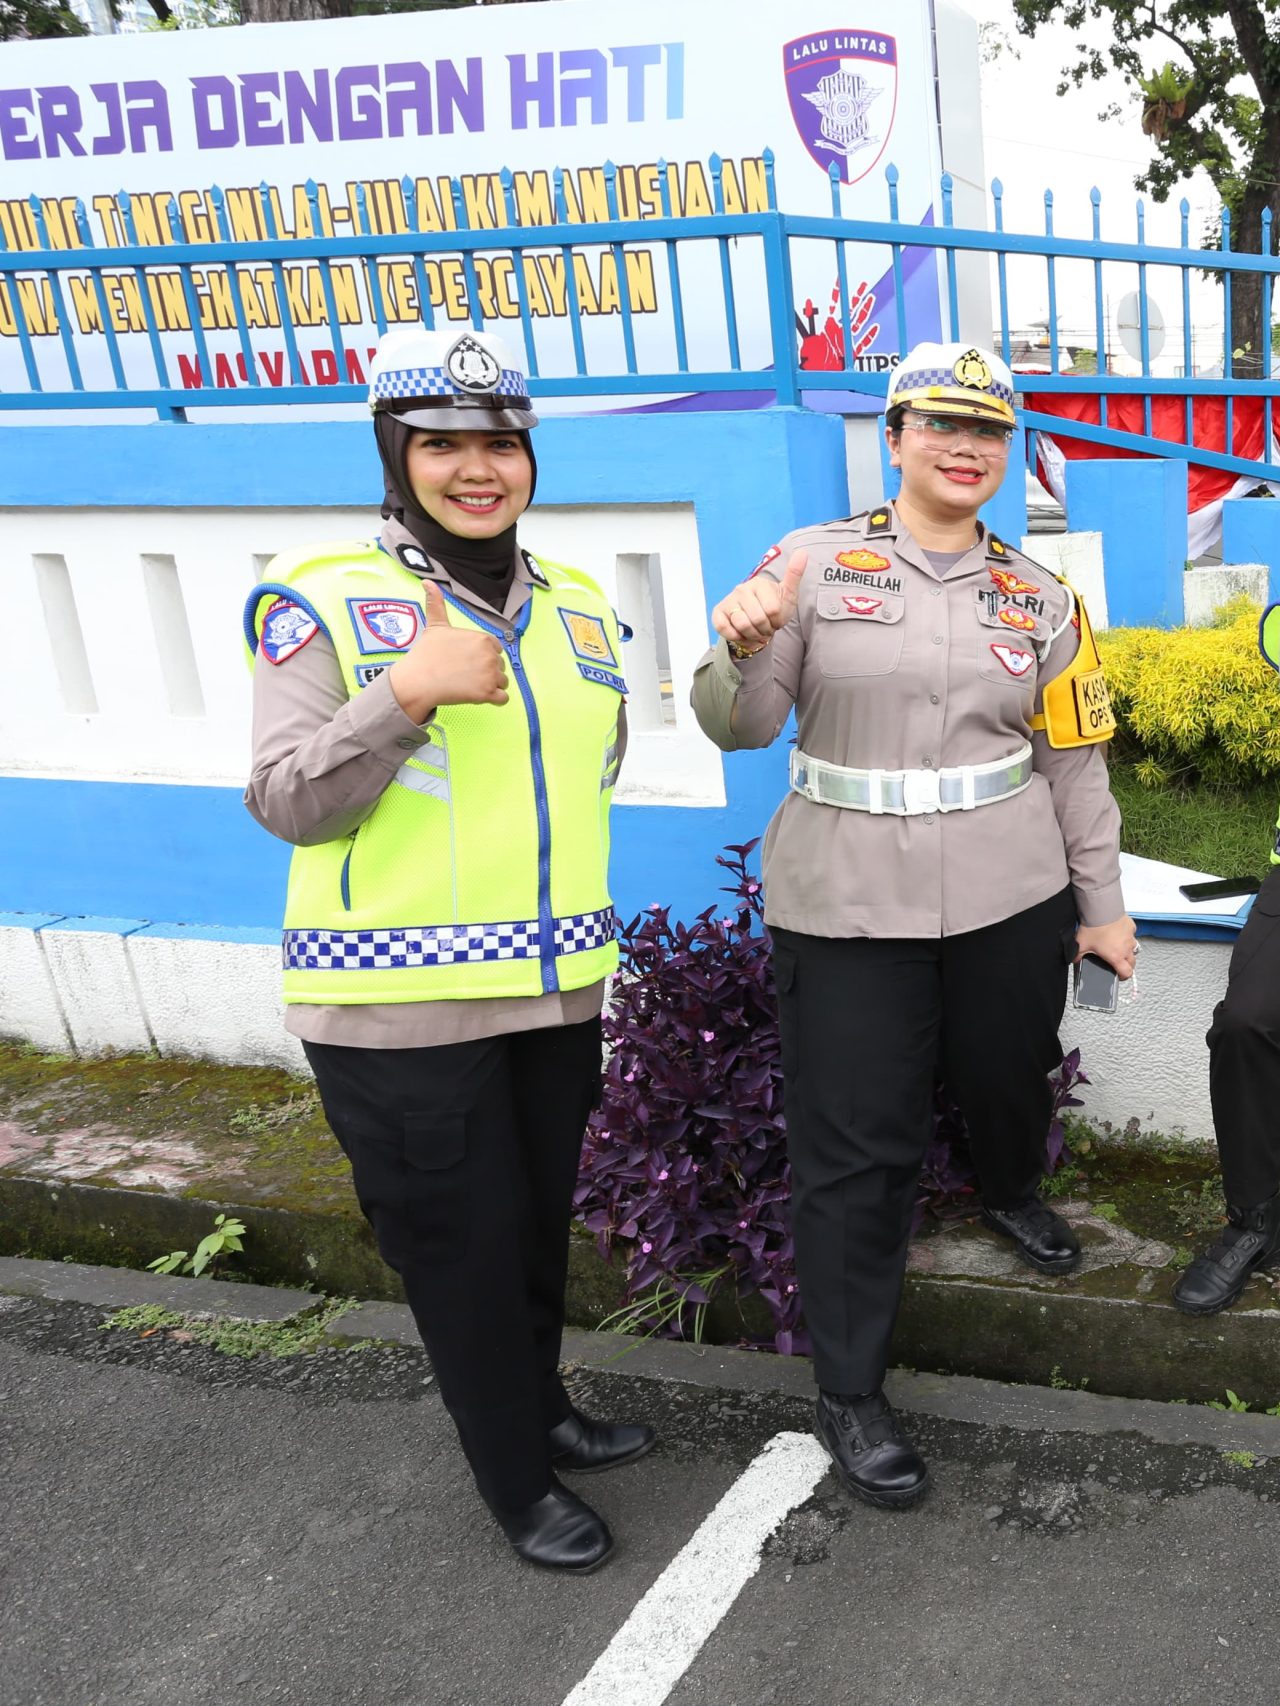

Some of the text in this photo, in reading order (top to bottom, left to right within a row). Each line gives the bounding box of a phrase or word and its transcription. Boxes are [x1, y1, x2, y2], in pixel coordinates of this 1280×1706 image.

[793, 36, 888, 60] LALU LINTAS
[189, 57, 485, 149] DENGAN
[505, 42, 684, 130] HATI
[363, 250, 658, 324] KEPERCAYAAN
[824, 567, 901, 592] GABRIELLAH
